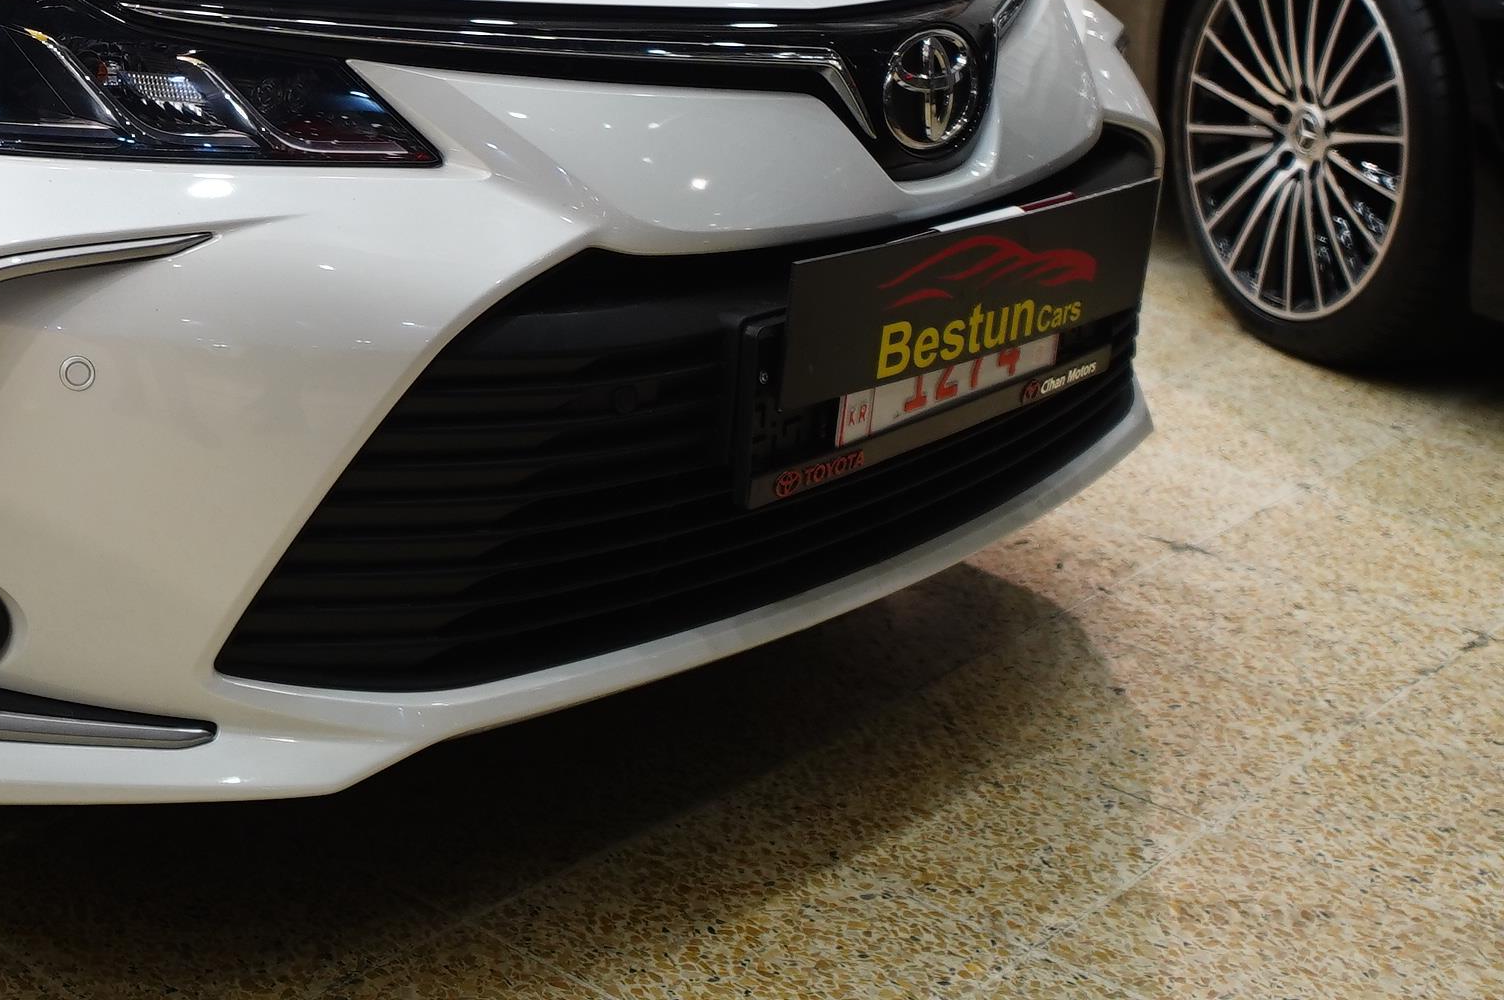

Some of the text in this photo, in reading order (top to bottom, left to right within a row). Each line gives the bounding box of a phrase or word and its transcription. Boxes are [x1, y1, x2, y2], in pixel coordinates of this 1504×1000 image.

[877, 299, 1034, 379] Bestun
[1067, 362, 1096, 383] Motors
[805, 450, 864, 485] TOYOTA
